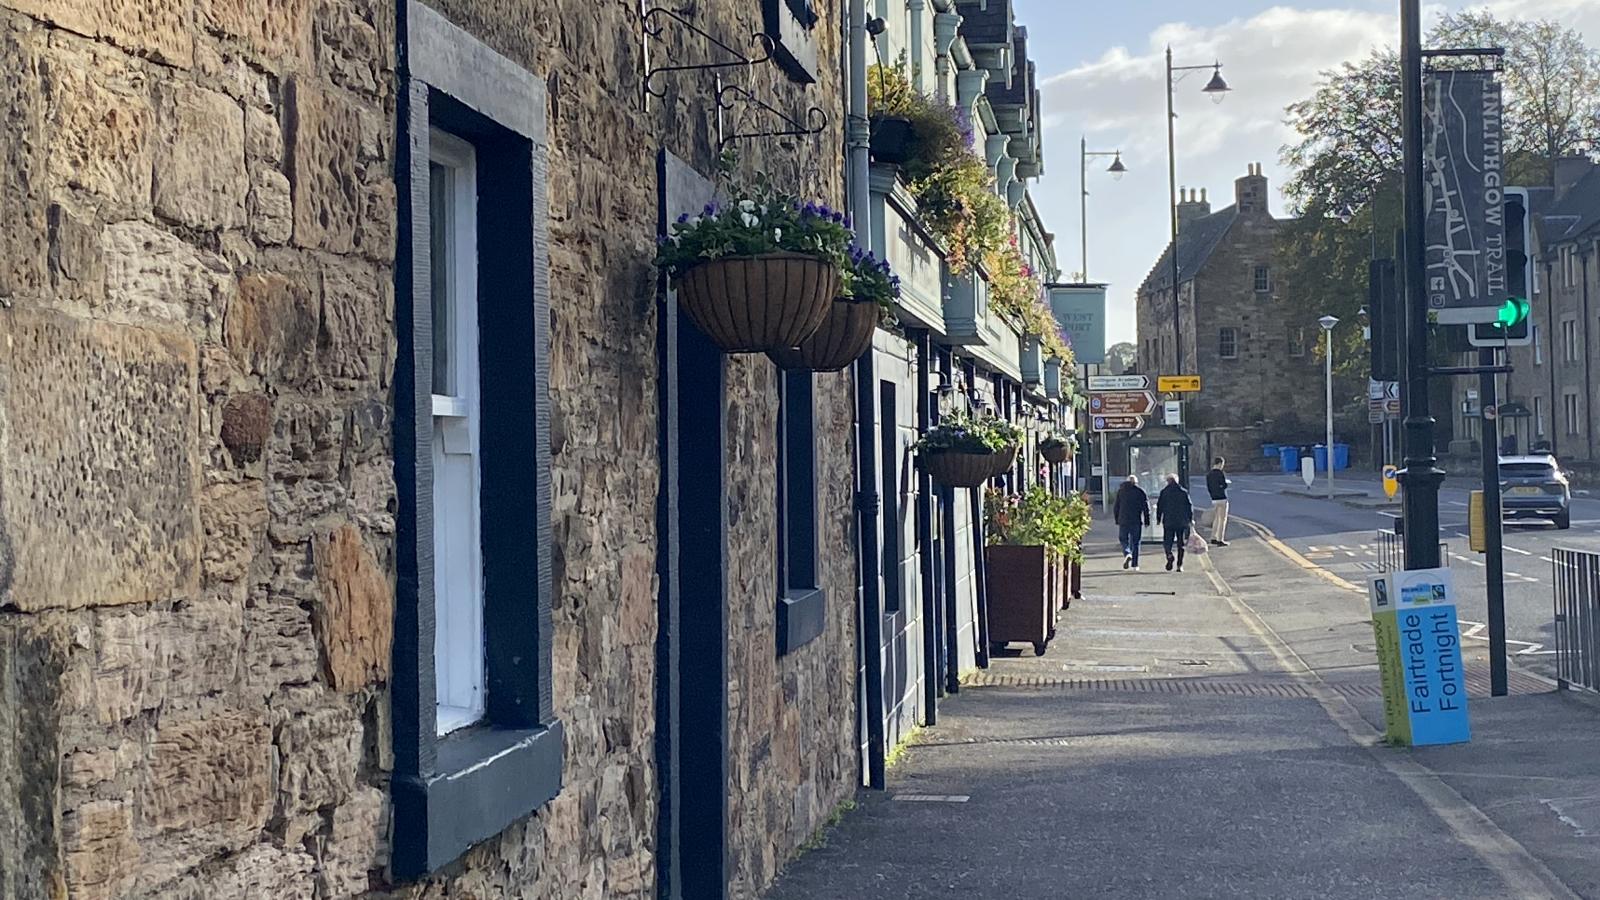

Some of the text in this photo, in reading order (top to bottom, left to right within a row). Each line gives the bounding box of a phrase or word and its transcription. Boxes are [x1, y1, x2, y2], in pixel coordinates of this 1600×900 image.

[1485, 233, 1504, 296] TRAIL
[1062, 312, 1094, 321] WEST
[1402, 613, 1431, 713] Fairtrade
[1430, 612, 1459, 712] Fortnight
